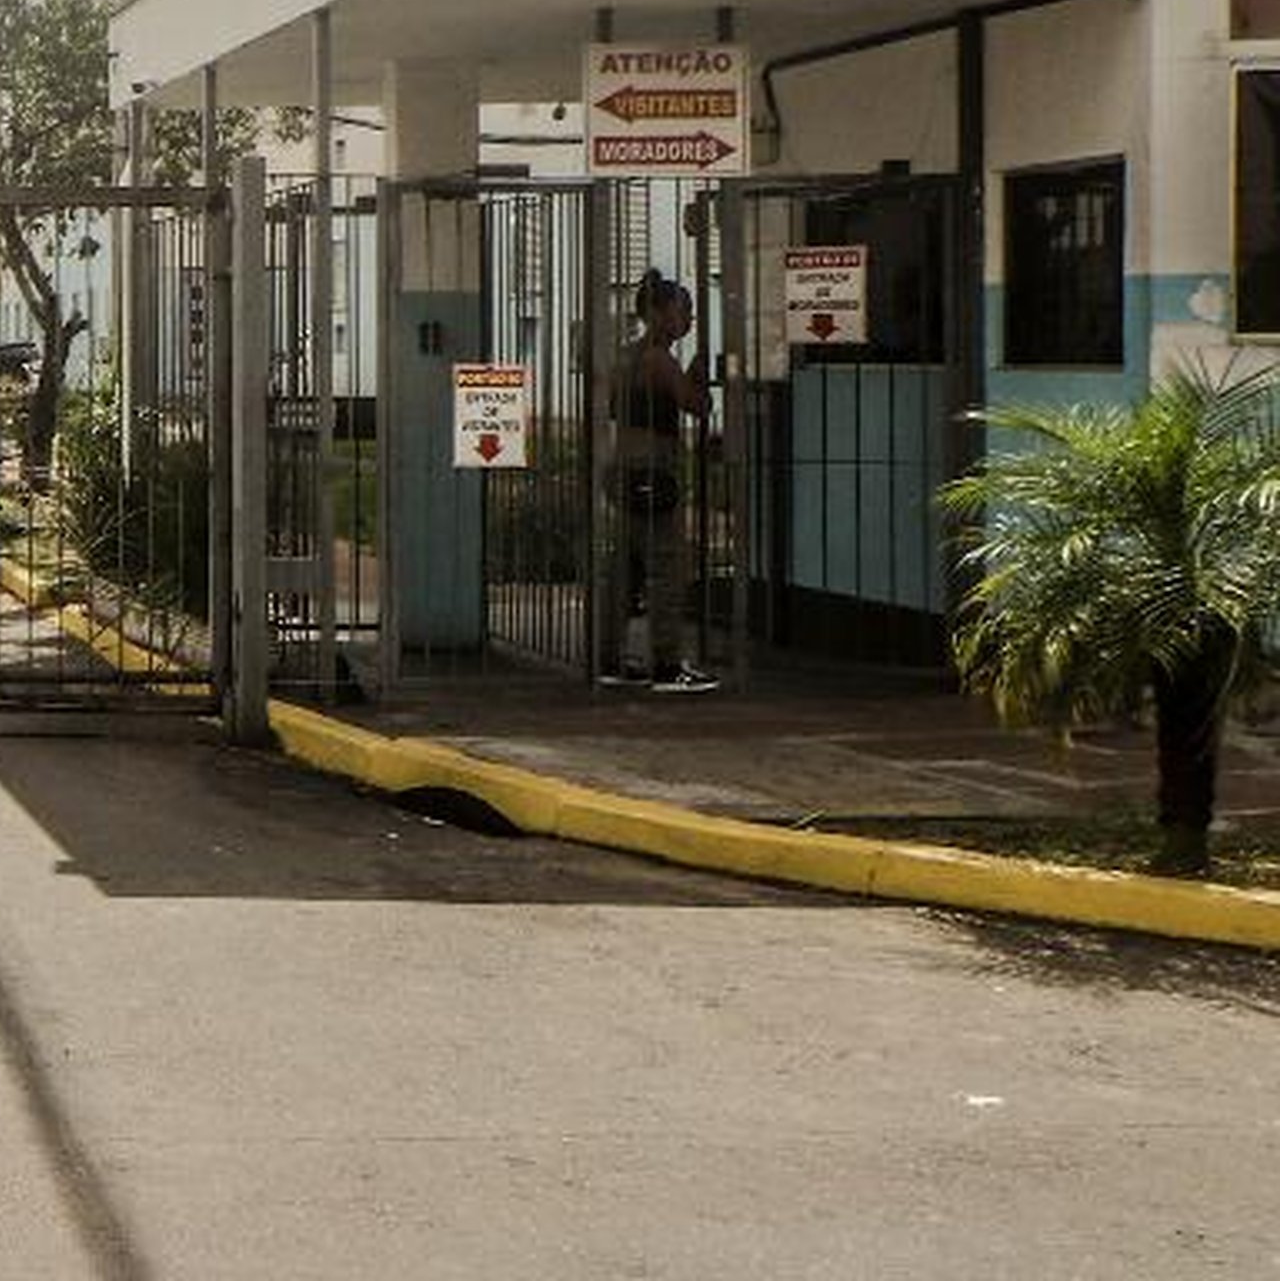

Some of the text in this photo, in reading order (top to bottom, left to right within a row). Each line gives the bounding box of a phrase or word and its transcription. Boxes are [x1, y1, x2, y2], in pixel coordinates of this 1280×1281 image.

[600, 50, 732, 77] ATENÇÃO
[615, 94, 734, 115] VISITANTES
[599, 140, 718, 162] MORADORES
